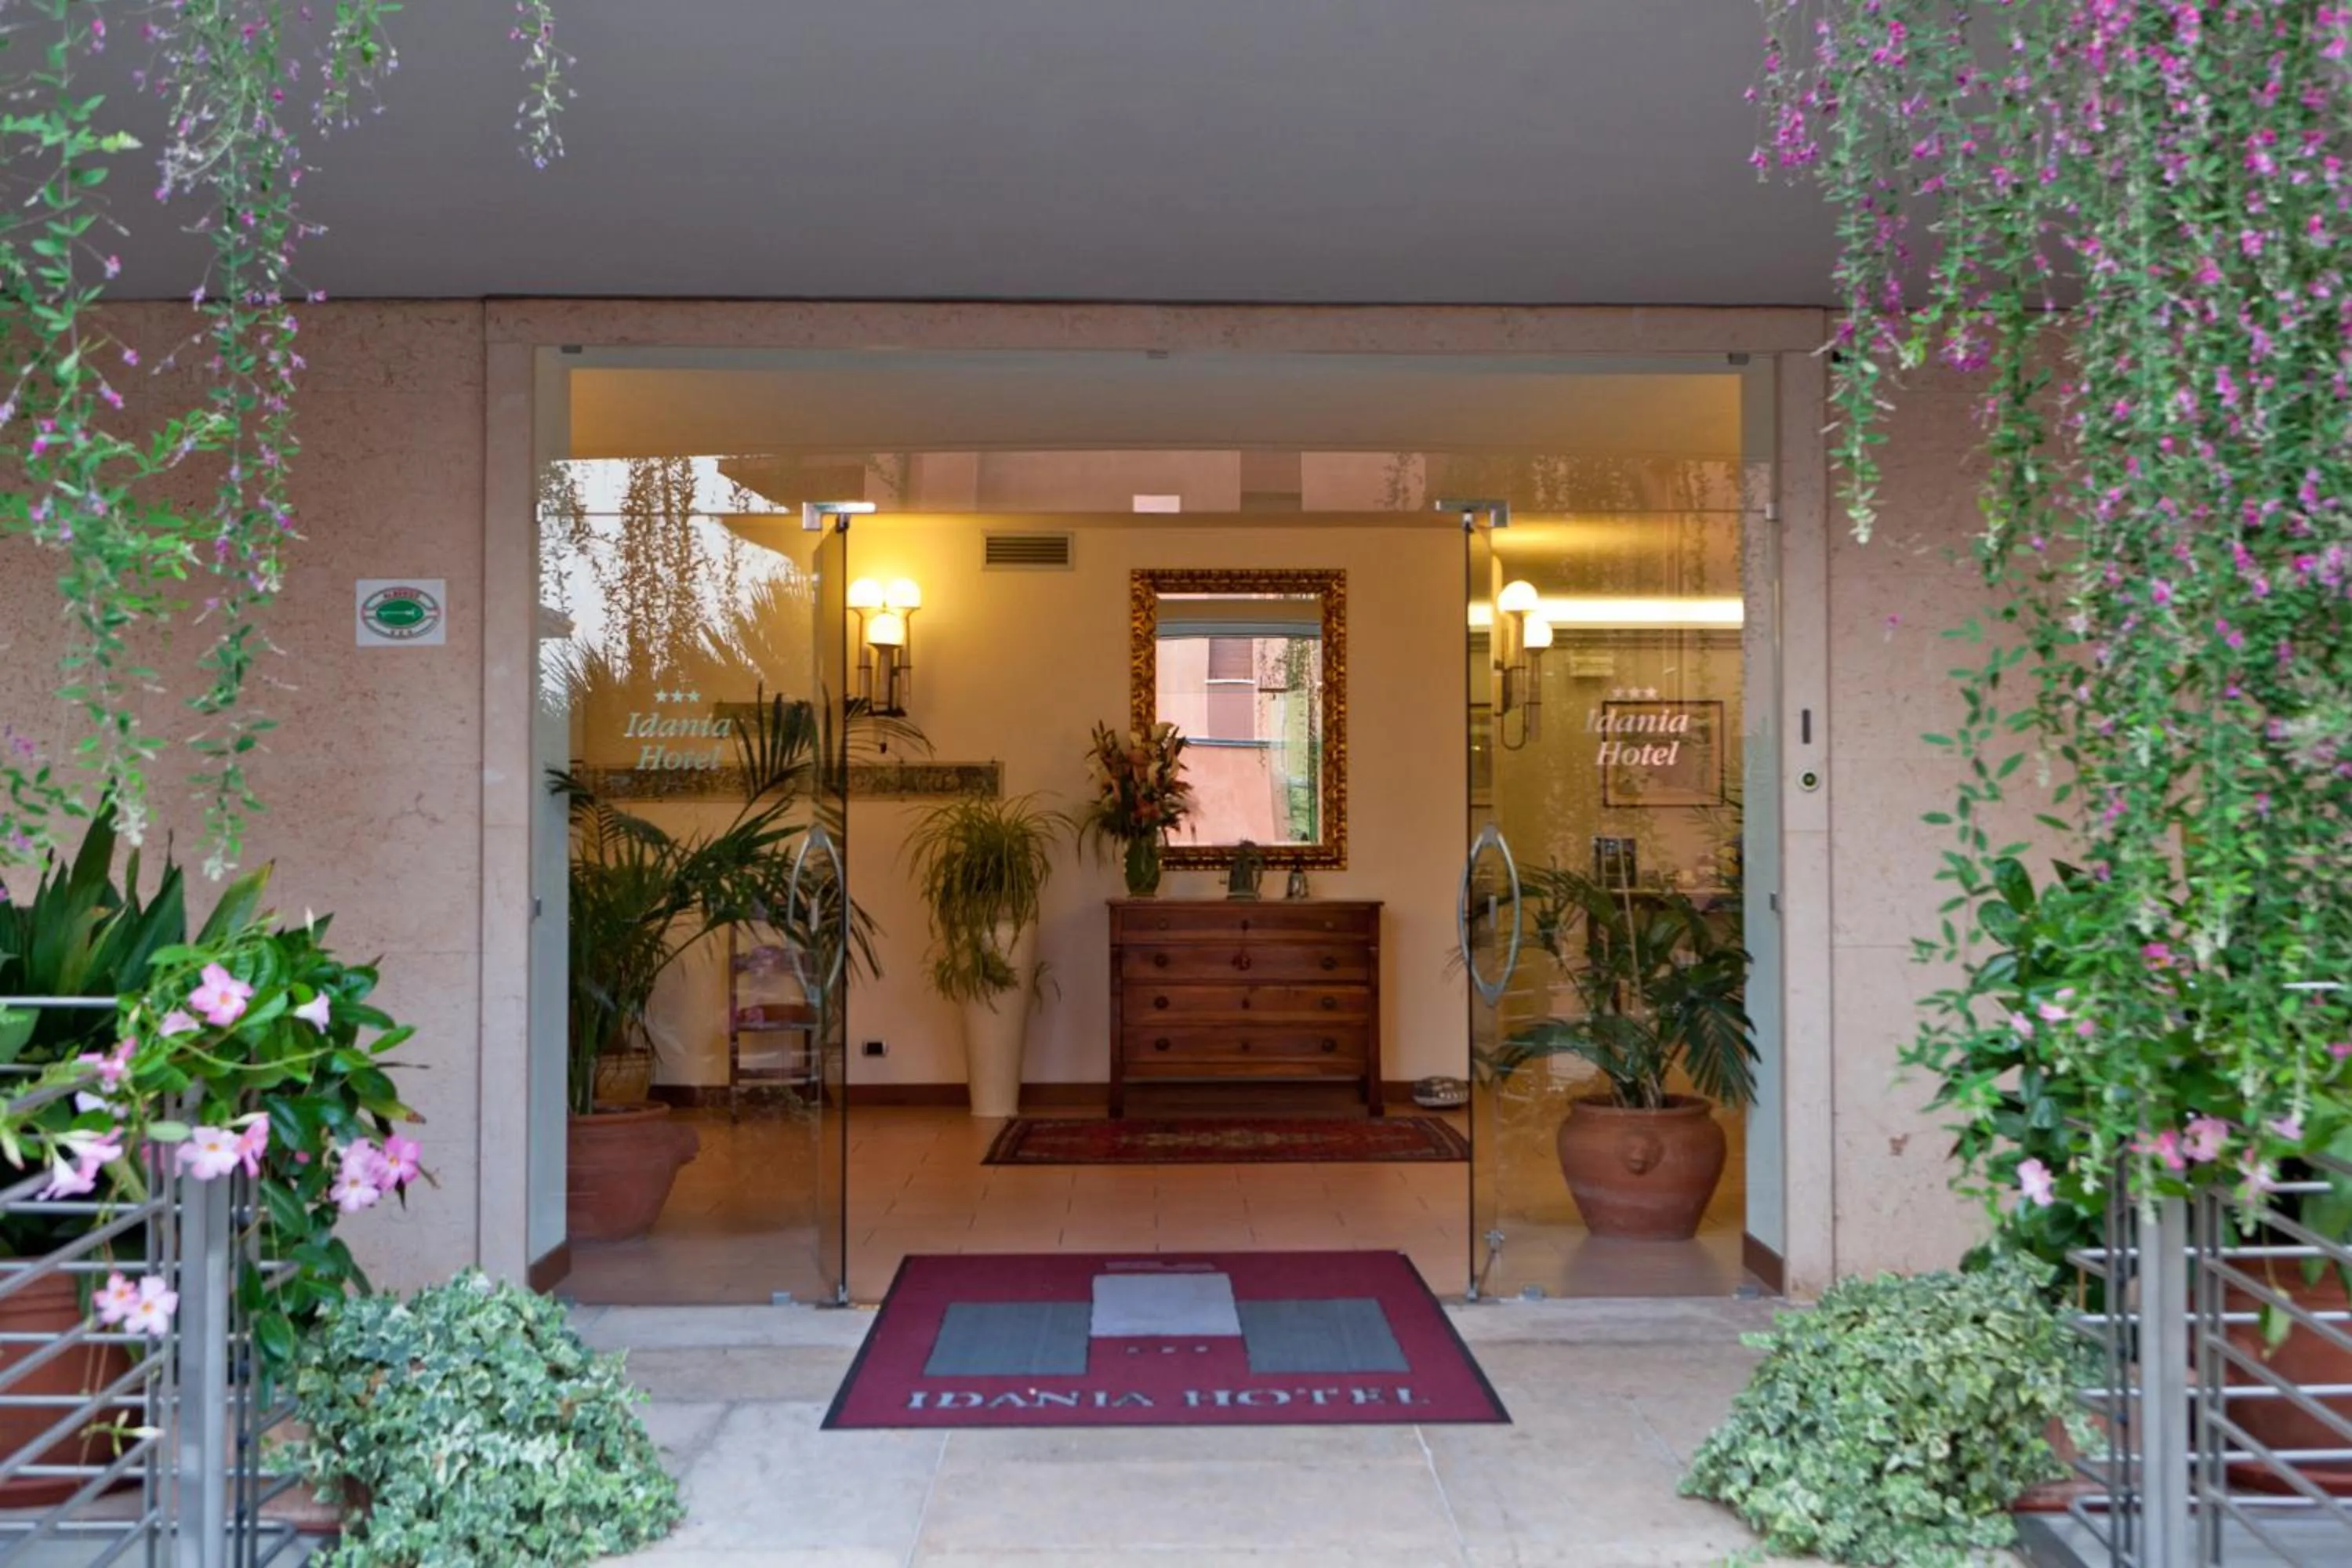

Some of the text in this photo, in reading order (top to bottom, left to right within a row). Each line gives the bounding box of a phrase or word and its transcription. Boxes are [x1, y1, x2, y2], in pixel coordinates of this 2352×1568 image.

[624, 712, 732, 738] Idania
[1584, 708, 1690, 733] Idania
[636, 744, 724, 771] Hotel
[1595, 740, 1680, 766] Hotel
[907, 1387, 1432, 1409] IDANIA HOTEL
